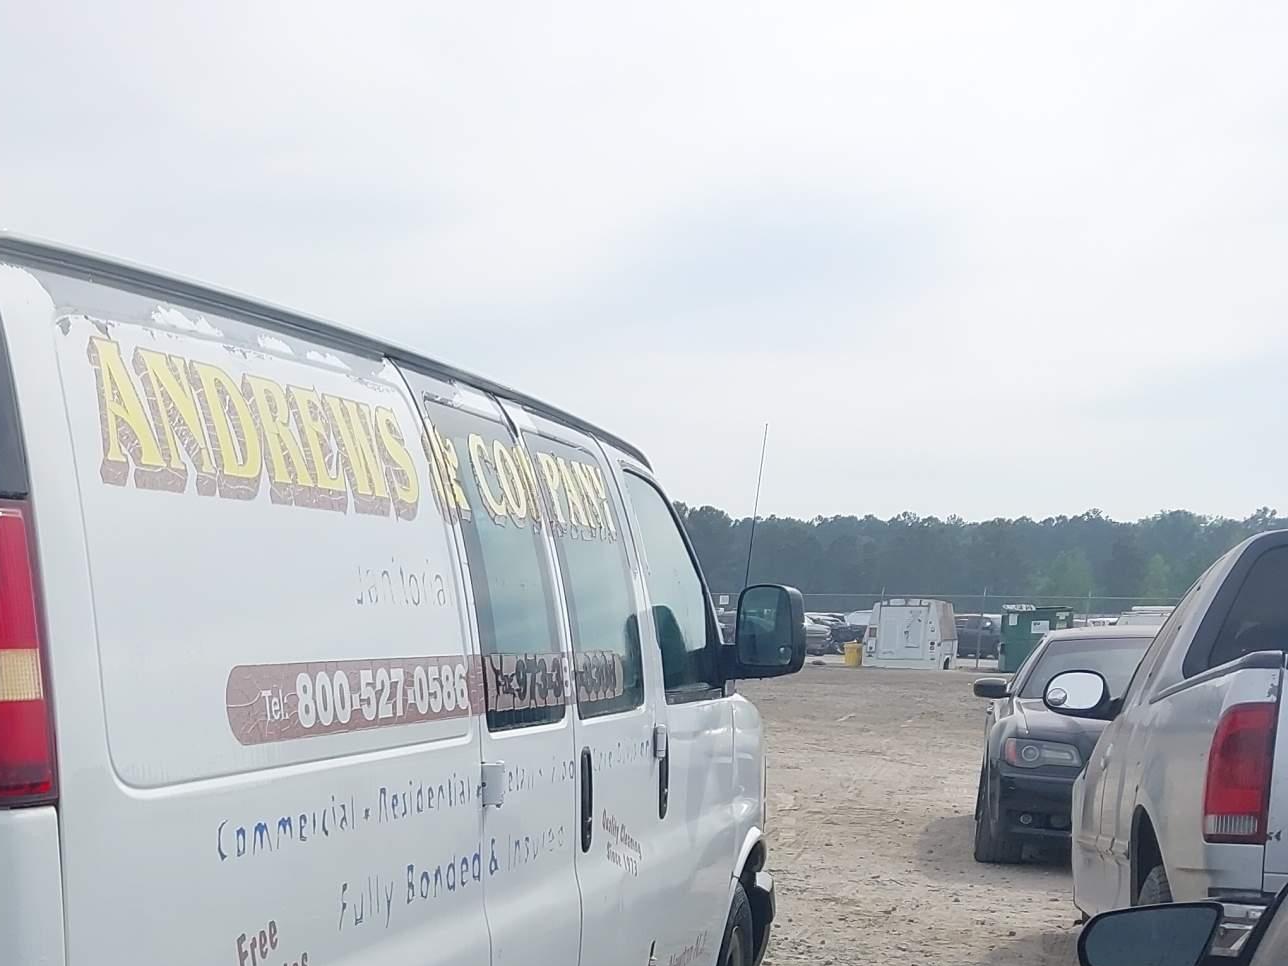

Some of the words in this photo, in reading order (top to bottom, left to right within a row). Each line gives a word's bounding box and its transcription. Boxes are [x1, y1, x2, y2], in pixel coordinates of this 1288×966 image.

[87, 334, 420, 522] ANDREWS
[421, 416, 472, 526] &
[262, 689, 289, 721] Tel:
[296, 663, 469, 729] 800-527-0586
[217, 795, 356, 861] Commercial
[378, 773, 471, 825] Residential
[338, 875, 394, 931] Fully
[406, 842, 481, 905] Bonded
[488, 837, 500, 876] &
